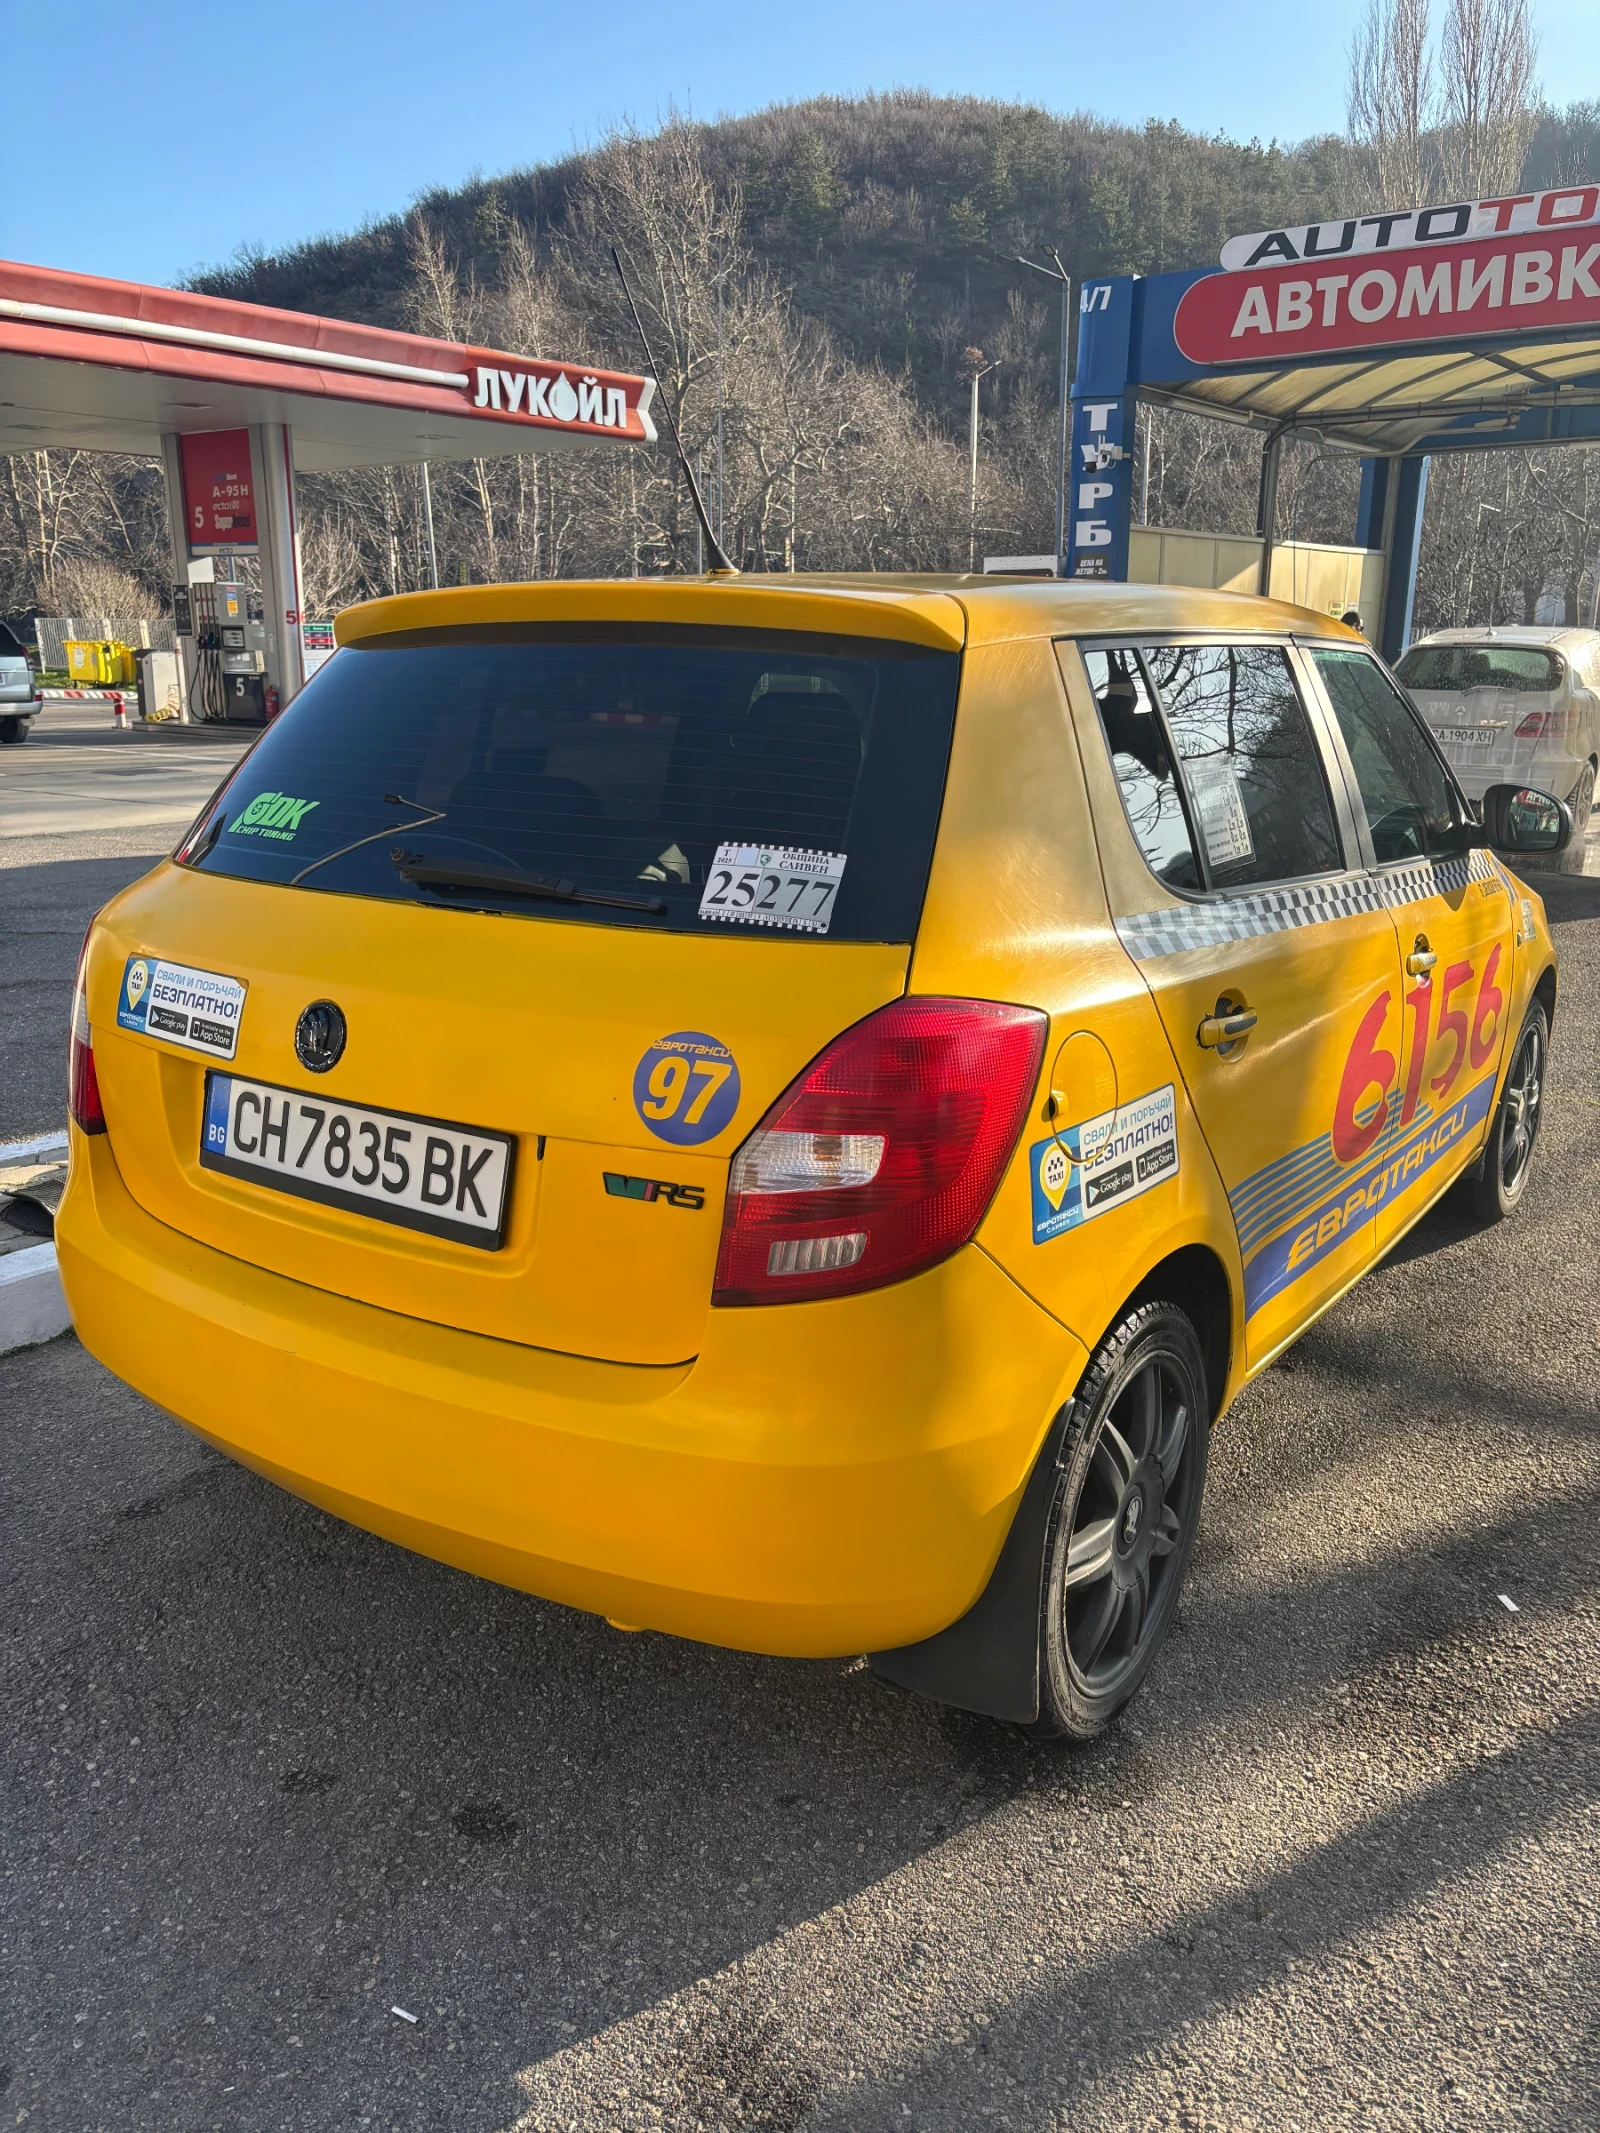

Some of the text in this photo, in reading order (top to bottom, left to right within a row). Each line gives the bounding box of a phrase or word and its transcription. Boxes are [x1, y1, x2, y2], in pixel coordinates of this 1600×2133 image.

[474, 366, 628, 429] ЛУКОЙЛ
[194, 506, 205, 528] 5
[285, 610, 297, 625] 5
[235, 677, 245, 697] 5
[235, 825, 260, 836] CHIP
[717, 856, 733, 864] 2025
[779, 861, 830, 875] СЛИВЕН
[782, 853, 830, 865] ОБЩИНА
[131, 981, 142, 991] TAXI
[156, 969, 242, 999] СВАЛИ И ПОРЪЧАЙ
[152, 983, 239, 1019] БЕЗПЛАТНО!
[159, 1015, 177, 1029] Google
[176, 1020, 187, 1031] play
[199, 1030, 230, 1046] App Store
[1331, 942, 1503, 1164] 6156
[642, 1055, 733, 1125] 97
[1083, 1093, 1172, 1146] СВАЛИ И ПОРЪЧАЙ
[208, 1123, 226, 1144] BG
[1083, 1112, 1173, 1172] БЕЗПЛАТНО!
[1146, 1151, 1174, 1173] App Store
[1048, 1171, 1064, 1184] TAXI
[1100, 1176, 1121, 1194] Google
[1121, 1171, 1133, 1185] play
[1285, 1104, 1468, 1273] ЕВРОТАКСИ
[1046, 1218, 1071, 1234] СЛИВЕН
